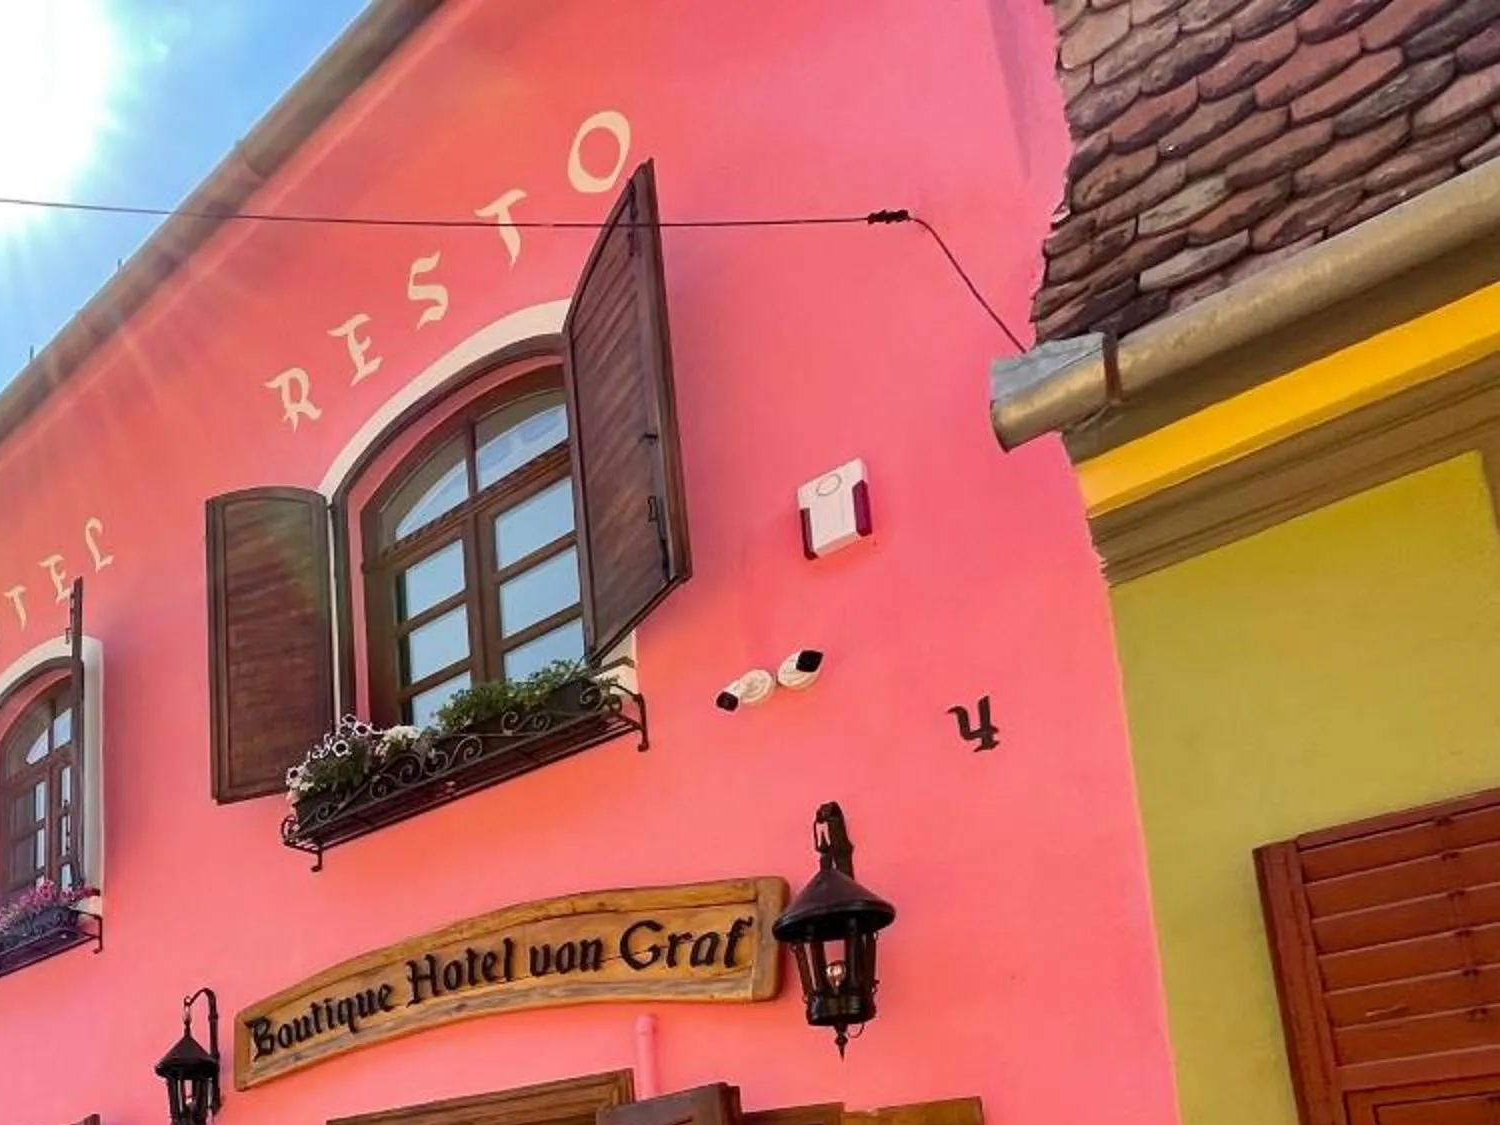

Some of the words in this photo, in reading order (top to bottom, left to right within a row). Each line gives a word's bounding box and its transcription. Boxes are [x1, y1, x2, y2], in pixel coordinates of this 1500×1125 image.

[265, 110, 632, 432] RESTO
[947, 695, 1000, 752] 4
[245, 984, 394, 1061] Boutique
[405, 938, 514, 1007] Hotel
[528, 938, 605, 977] von
[619, 915, 753, 971] Graf
